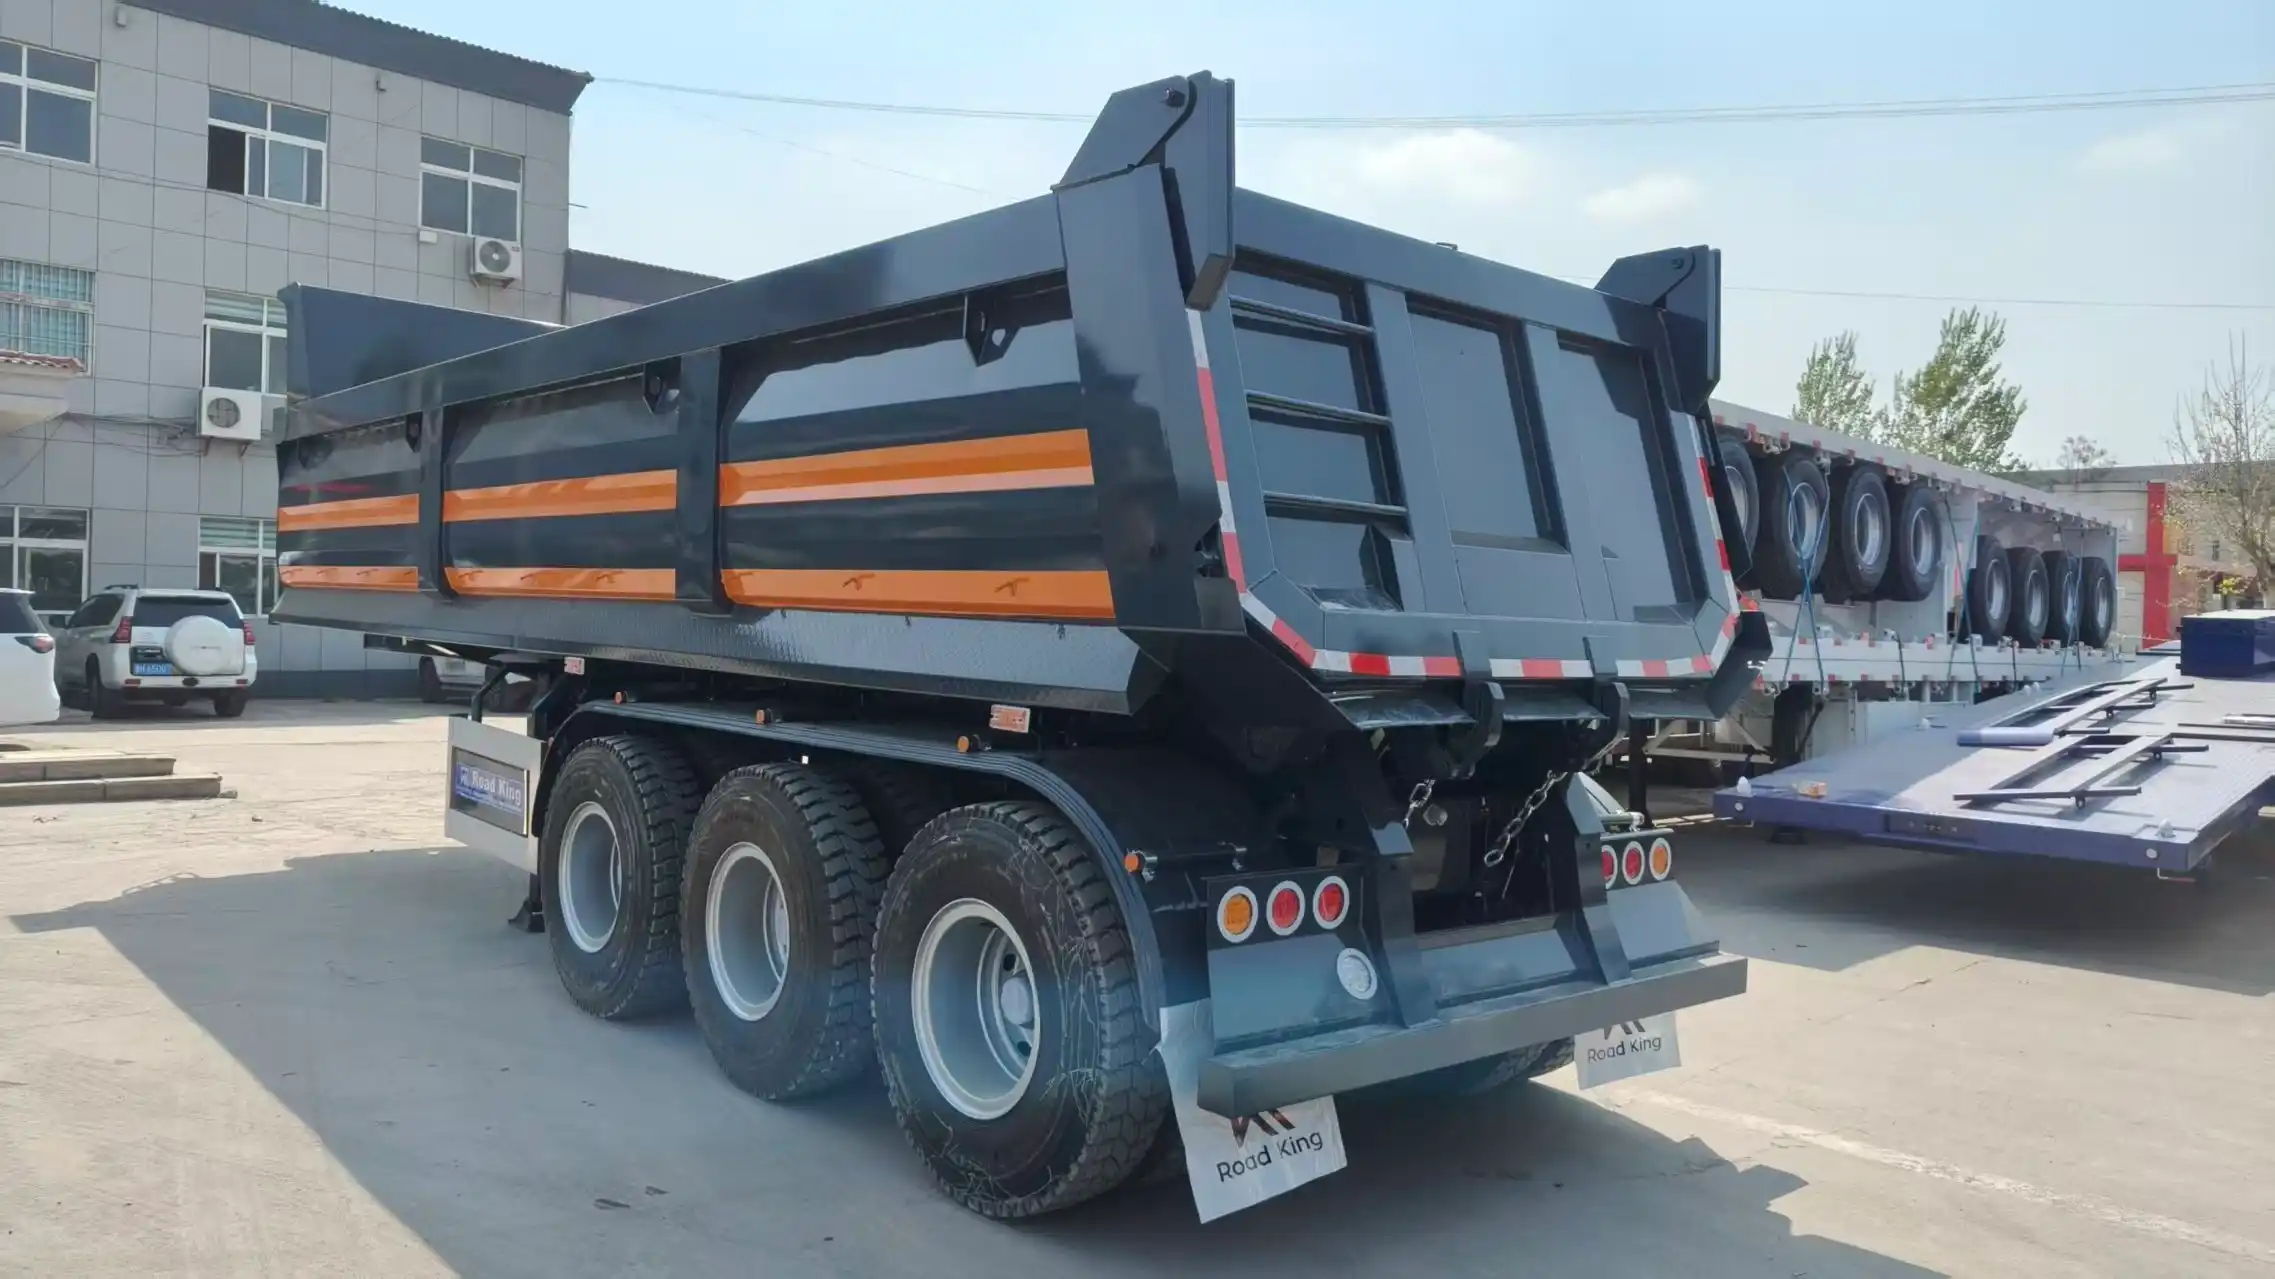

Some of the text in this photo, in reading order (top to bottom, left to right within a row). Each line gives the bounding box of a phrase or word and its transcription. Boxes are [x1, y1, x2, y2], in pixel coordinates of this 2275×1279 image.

[471, 769, 496, 793] Road
[498, 780, 521, 807] King
[1587, 1036, 1662, 1064] Road King
[1216, 1132, 1323, 1183] Road King
